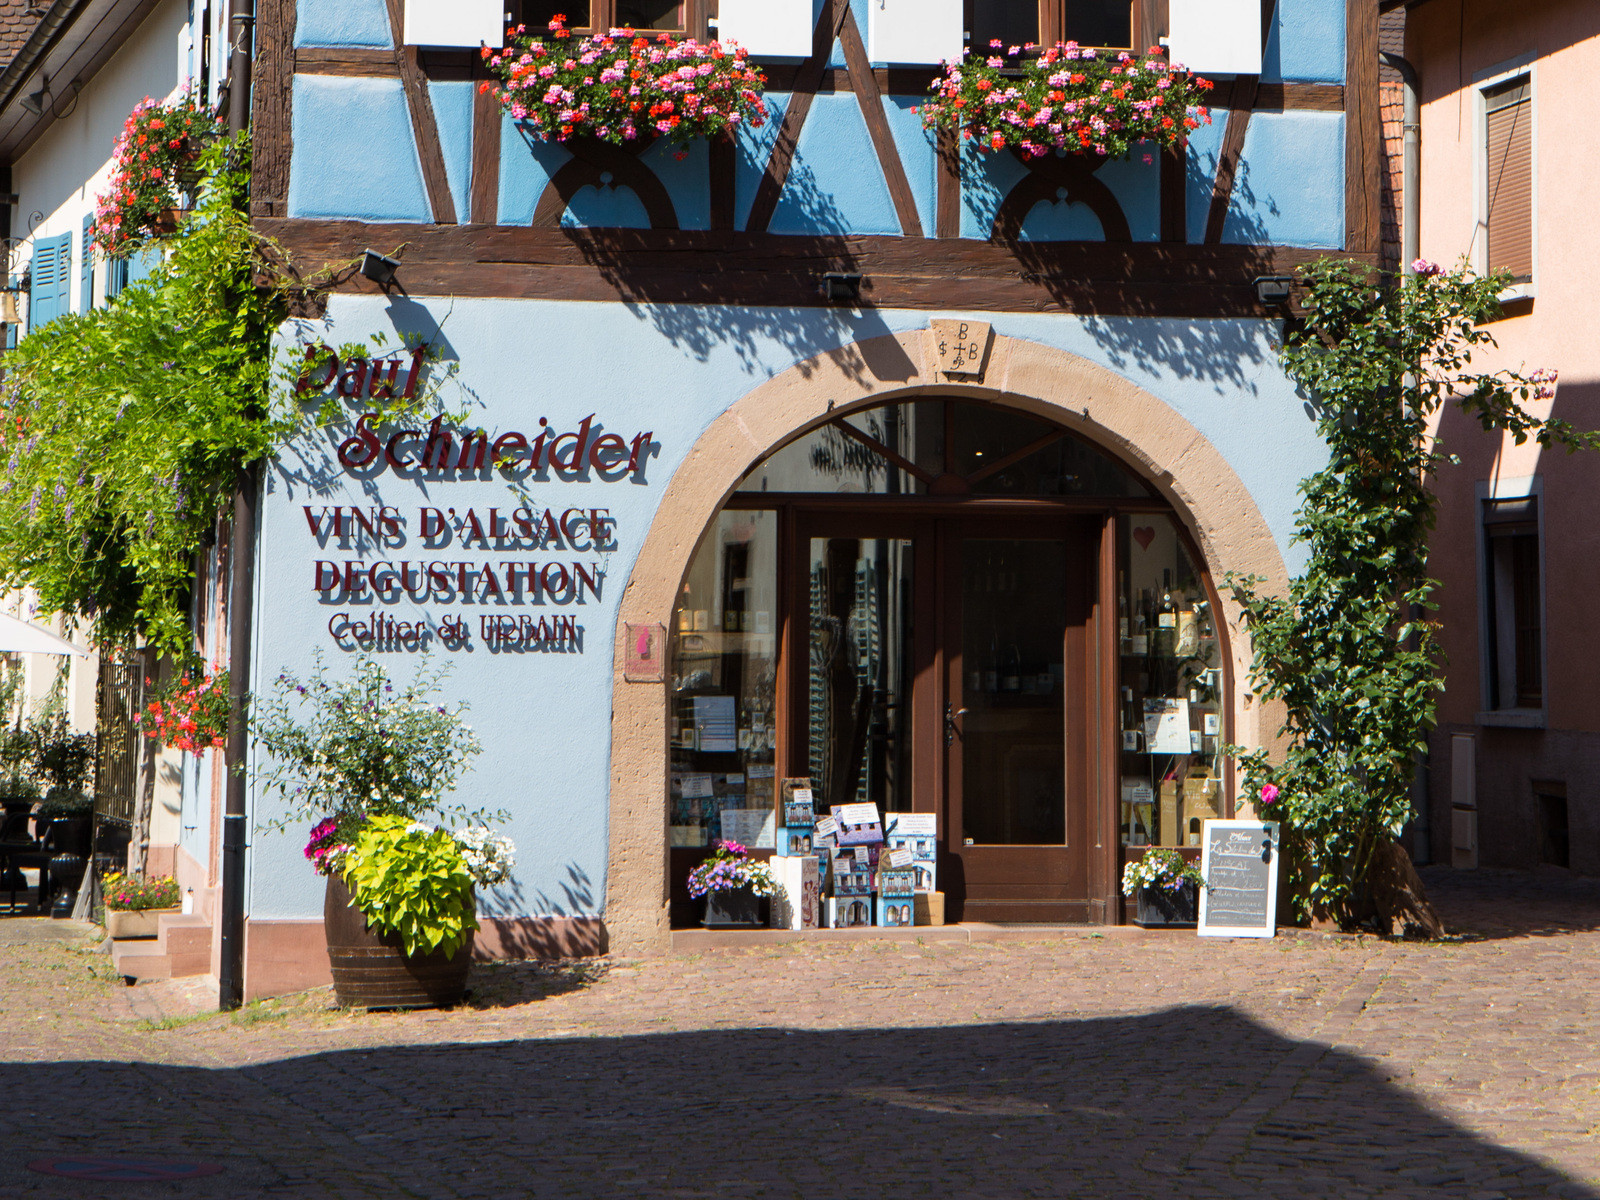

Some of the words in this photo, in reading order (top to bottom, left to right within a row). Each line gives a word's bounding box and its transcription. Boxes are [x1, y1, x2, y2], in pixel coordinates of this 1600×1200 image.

[296, 342, 429, 399] Paul
[337, 412, 653, 472] Schneider
[302, 505, 399, 538] VINS
[312, 559, 599, 593] DEGUSTATION
[328, 611, 425, 640] Cellier
[437, 613, 467, 640] St
[480, 614, 577, 641] URBAIN
